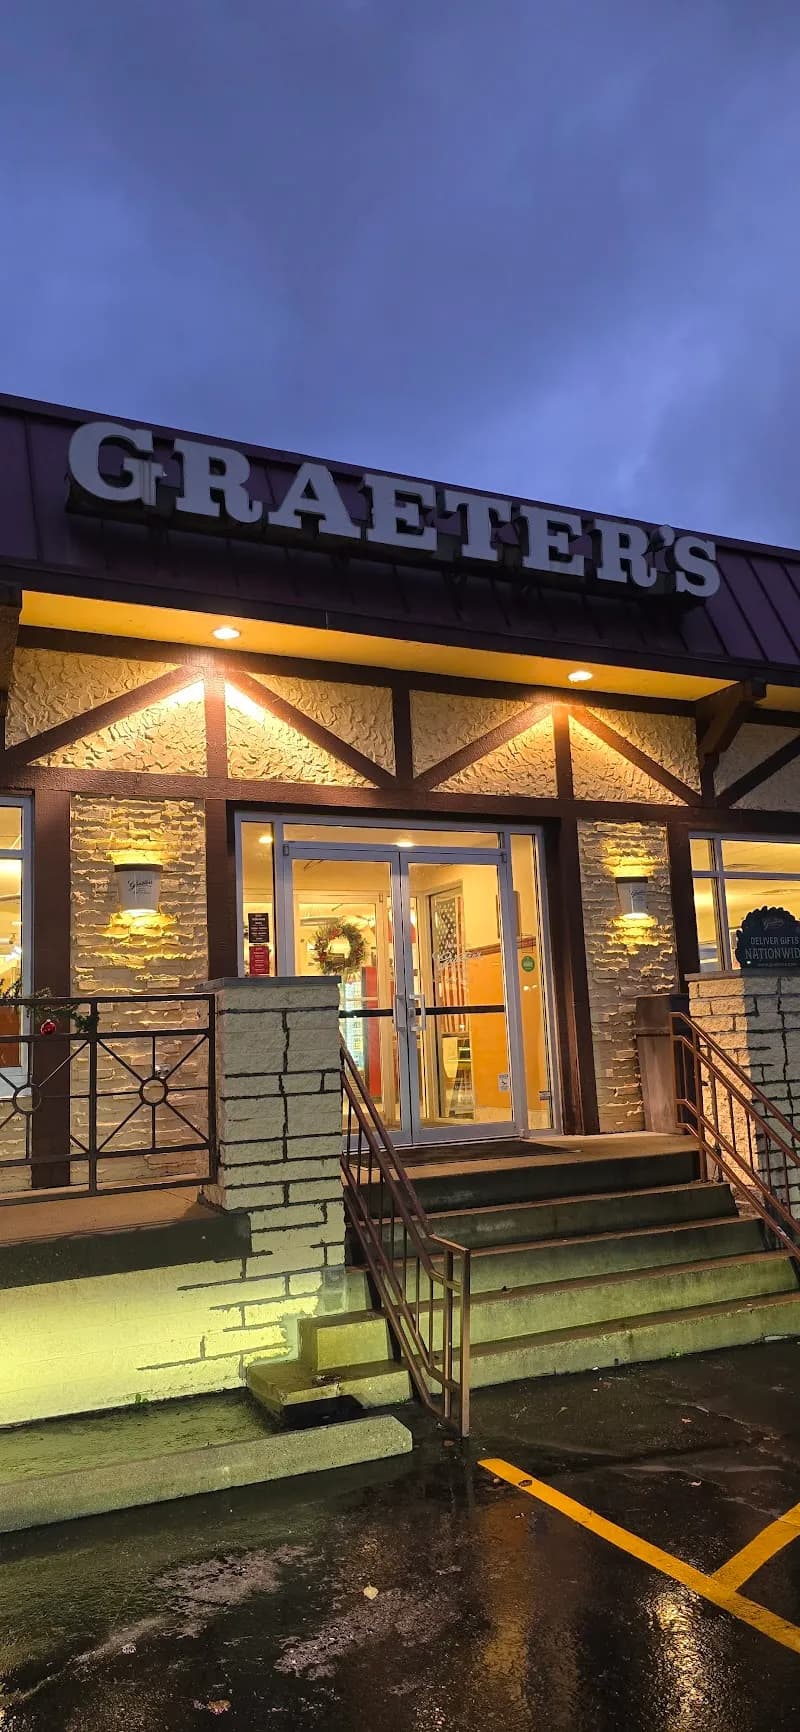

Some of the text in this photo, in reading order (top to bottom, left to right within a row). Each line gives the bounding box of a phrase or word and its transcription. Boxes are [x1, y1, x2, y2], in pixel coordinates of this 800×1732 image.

[68, 422, 721, 598] GRAETER'S
[750, 936, 799, 945] DELIVER GIFTS
